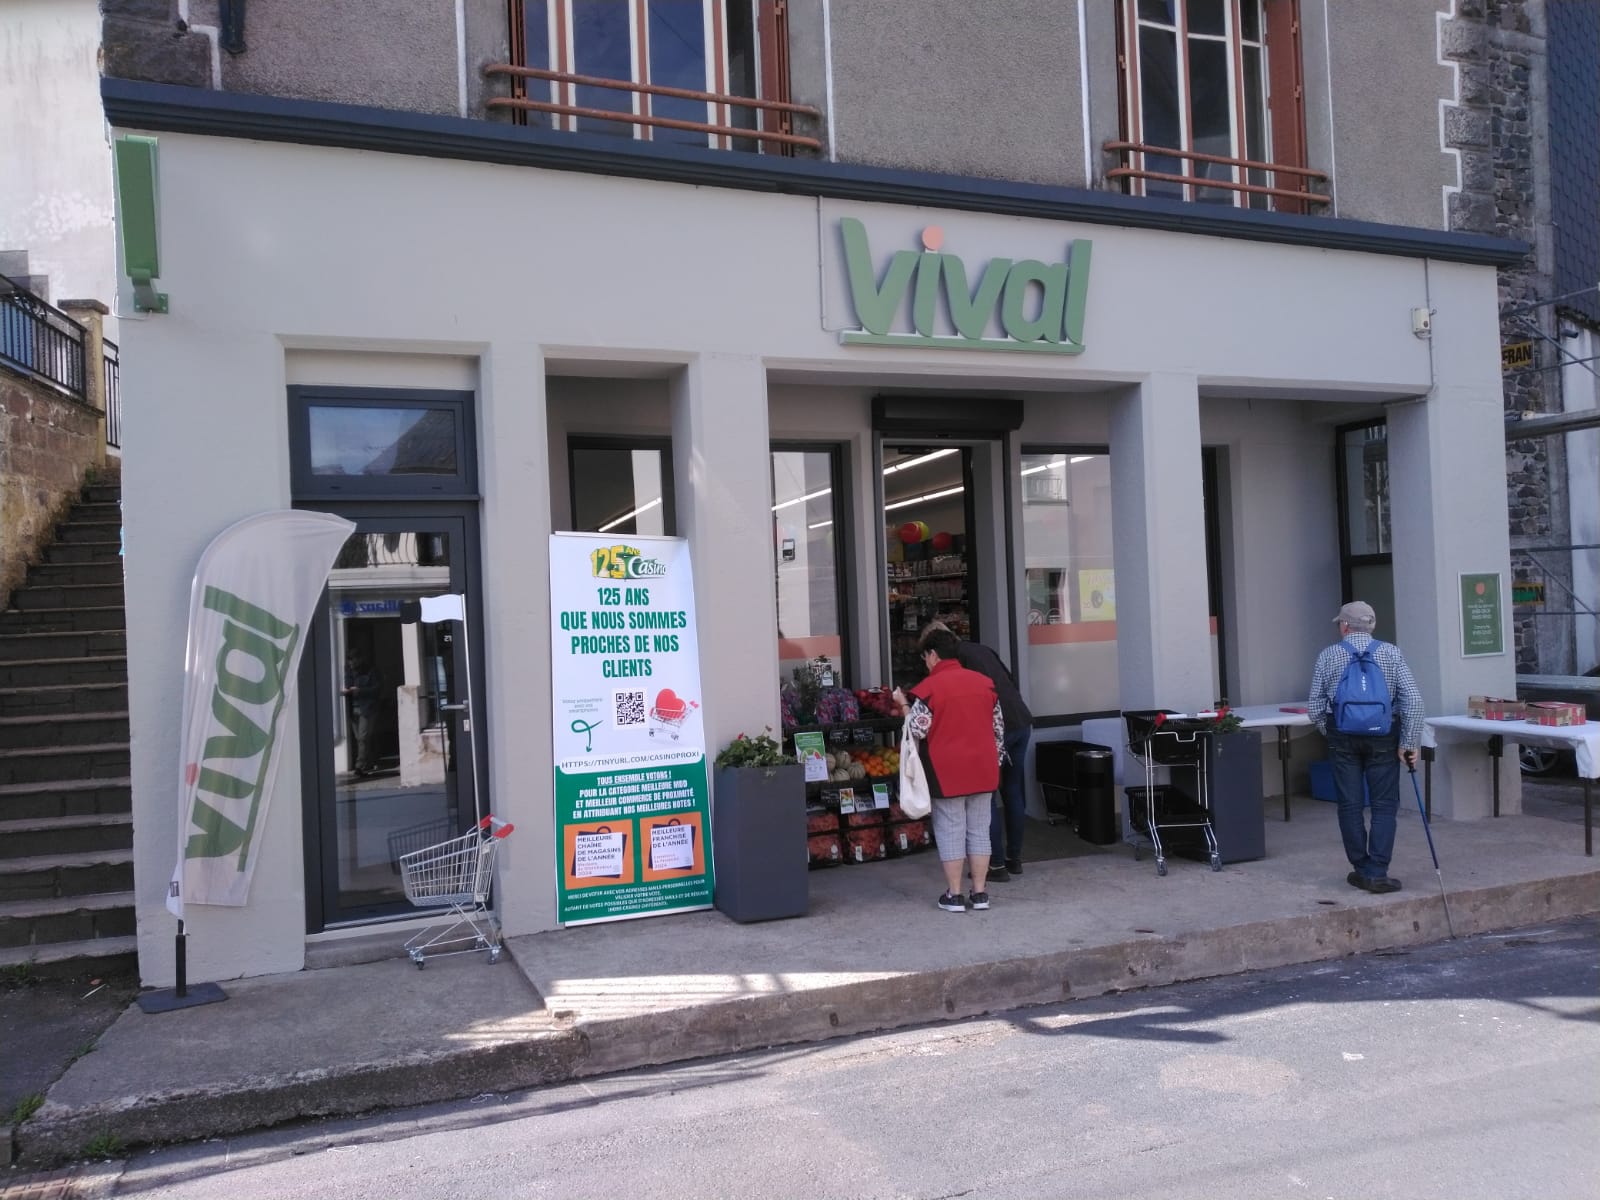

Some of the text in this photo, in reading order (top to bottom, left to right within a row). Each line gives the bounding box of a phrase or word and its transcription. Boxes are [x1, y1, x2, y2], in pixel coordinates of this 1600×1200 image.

[591, 545, 626, 578] 125
[628, 556, 666, 578] Casino
[598, 588, 650, 605] 125 ANS
[561, 610, 687, 631] QUE NOUS SOMMES
[571, 635, 679, 654] PROCHES DE NOS
[602, 659, 652, 678] CLIENTS
[597, 776, 613, 785] TOUS
[575, 800, 583, 808] ET
[585, 797, 617, 808] MEILLEUR
[618, 793, 653, 805] COMMERCE
[653, 792, 661, 801] DE
[579, 788, 598, 798] POUR
[599, 788, 607, 797] LA
[572, 810, 582, 819] EN
[583, 807, 622, 818] ATTRIBUANT
[652, 826, 685, 835] MEILLEURE
